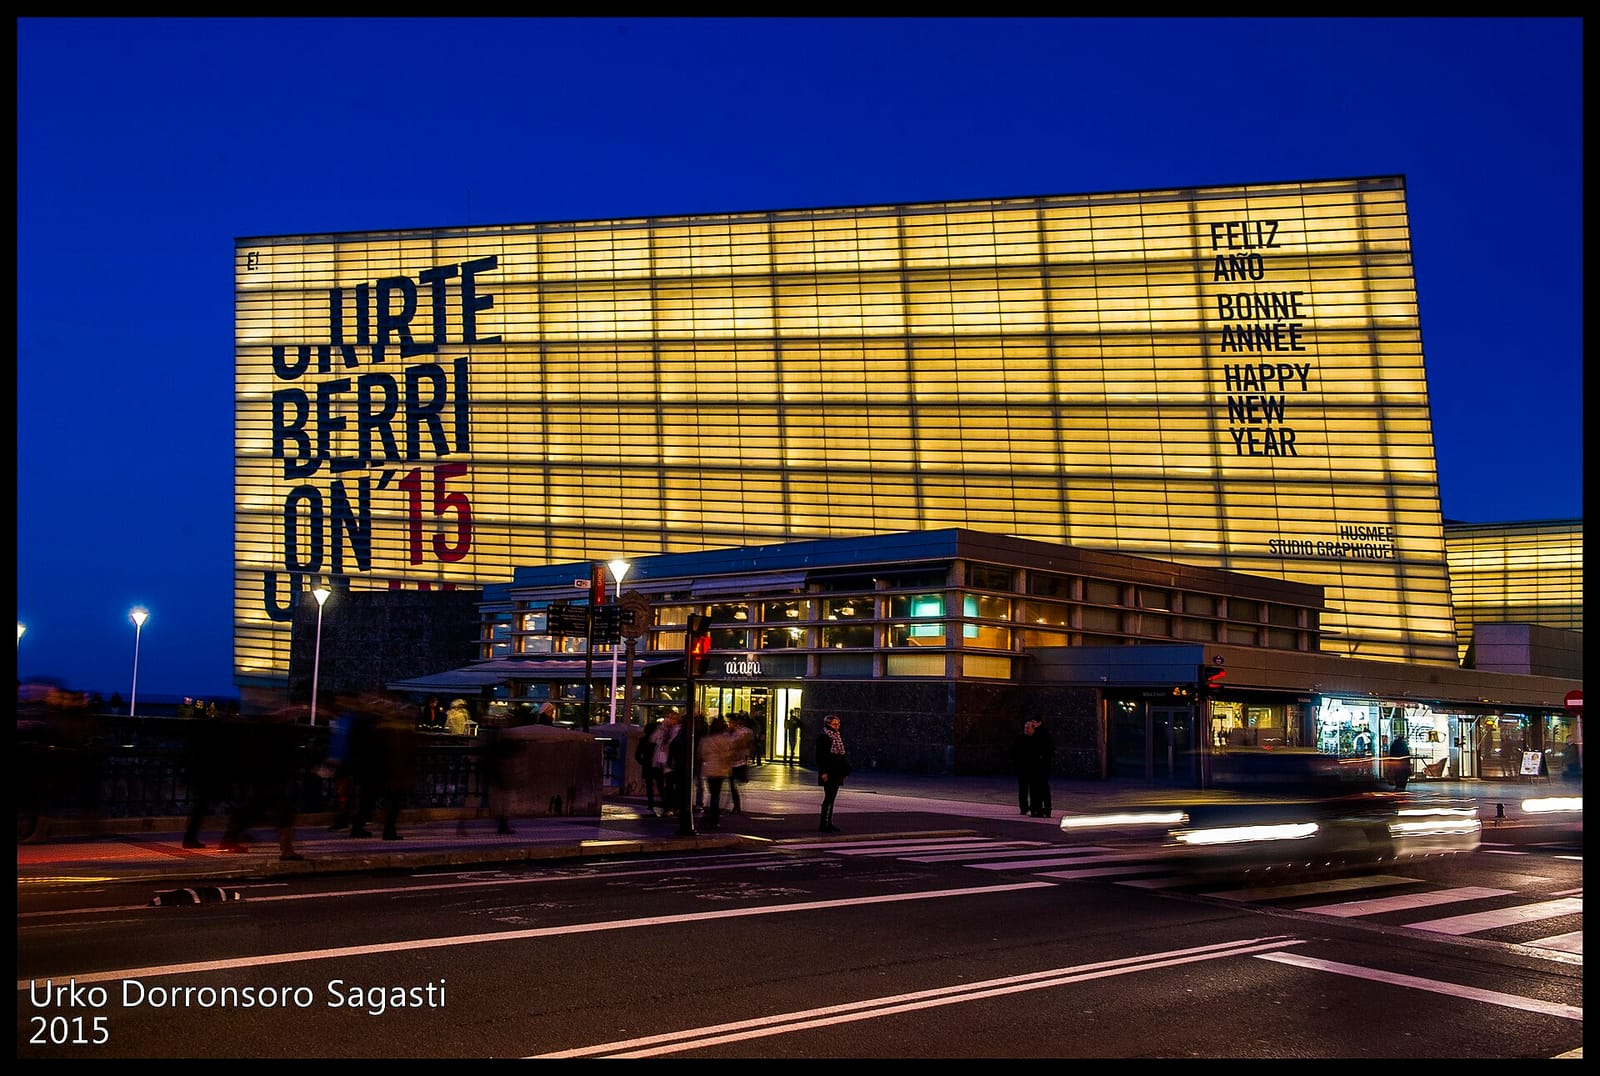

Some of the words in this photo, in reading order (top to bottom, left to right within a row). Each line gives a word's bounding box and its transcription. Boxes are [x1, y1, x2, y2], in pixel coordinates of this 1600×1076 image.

[1210, 220, 1281, 250] FELIZ
[1213, 252, 1264, 281] AÑO
[1216, 291, 1307, 320] BONNE
[1221, 317, 1306, 352] ANNÉE
[1224, 363, 1310, 392] HAPPY
[272, 356, 471, 481] BERRI
[1227, 395, 1285, 424] NEW
[1229, 427, 1298, 456] YEAR
[1340, 525, 1395, 542] HUSMEE
[1268, 539, 1313, 555] STUDIO
[1317, 541, 1396, 560] GRAPHIQUE!
